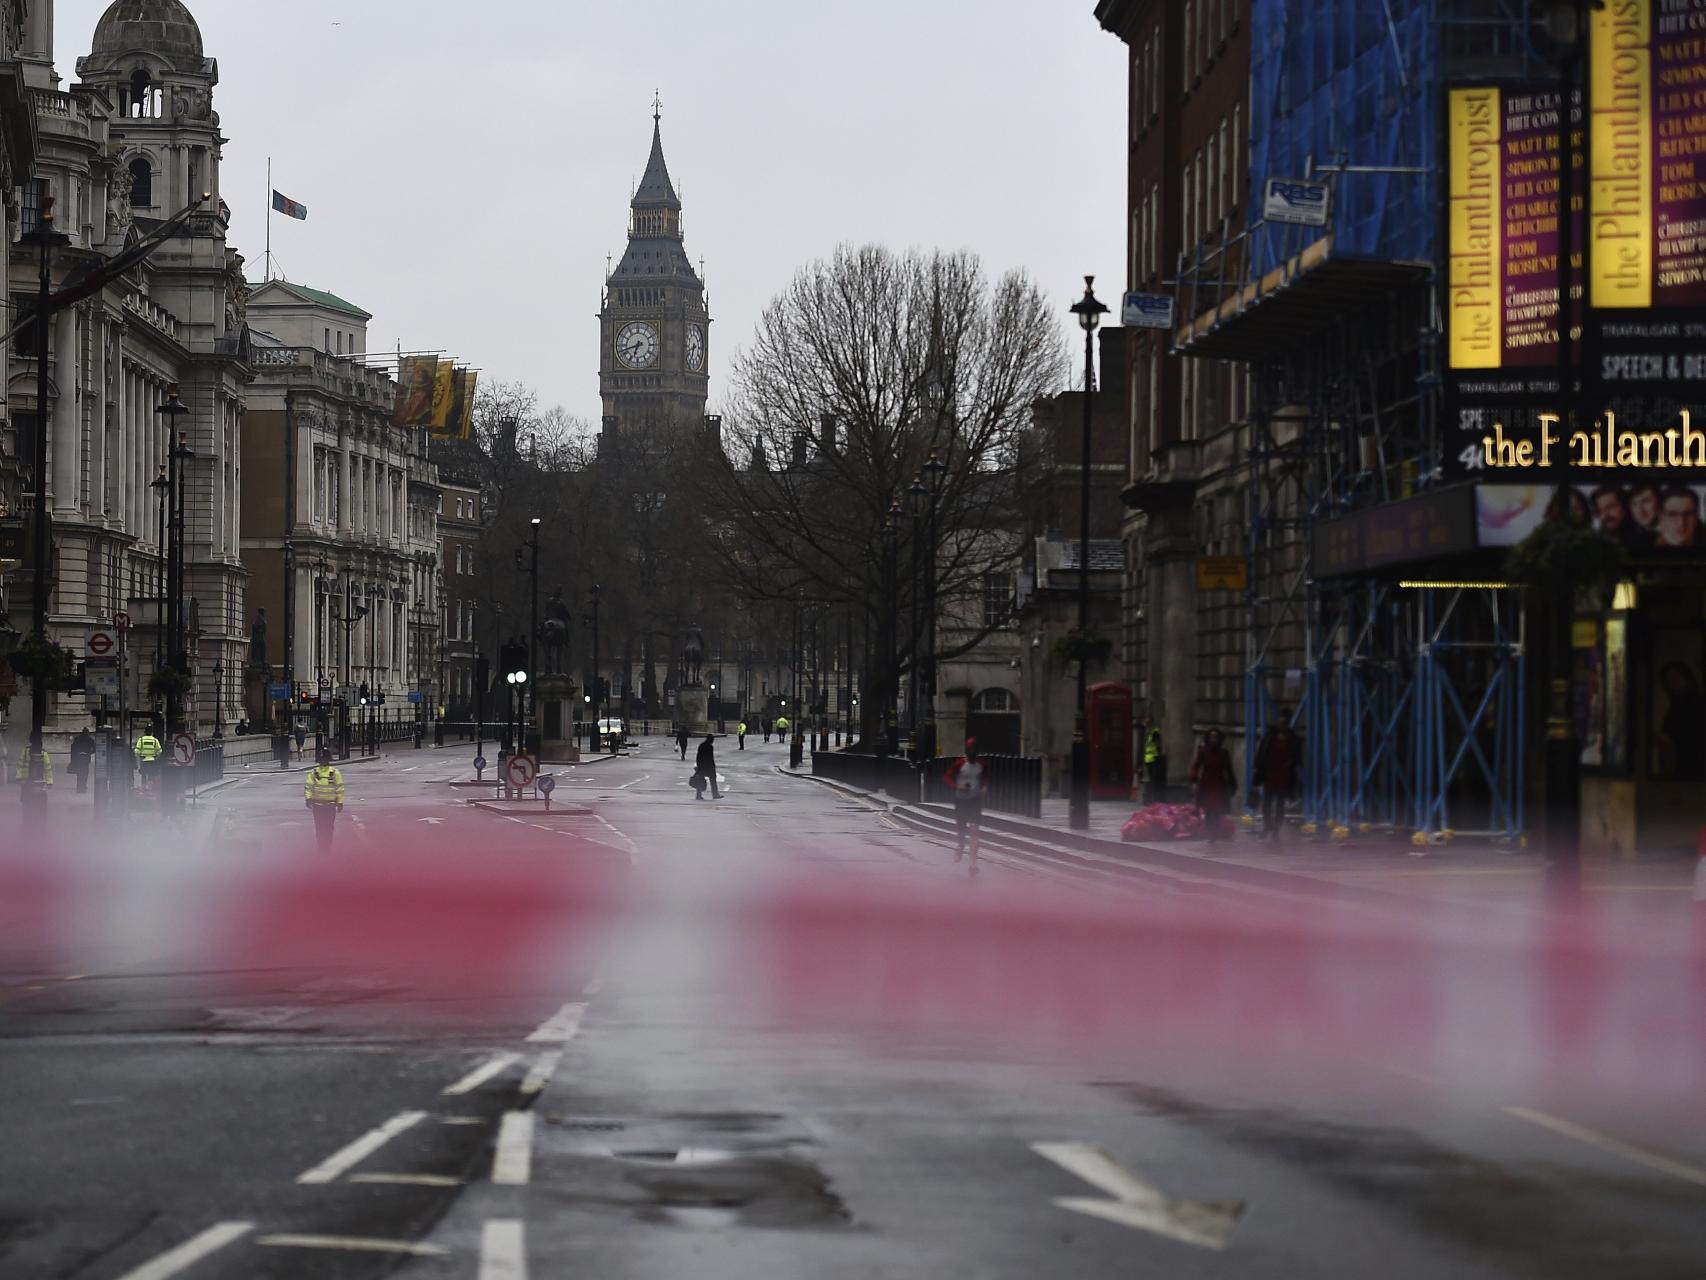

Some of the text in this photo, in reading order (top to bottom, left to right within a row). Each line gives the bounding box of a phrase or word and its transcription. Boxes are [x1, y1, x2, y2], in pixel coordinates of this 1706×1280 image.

[1449, 94, 1501, 351] the Philanthropist
[1604, 249, 1640, 290] the
[1601, 354, 1664, 381] SPEECH
[1483, 422, 1534, 467] the
